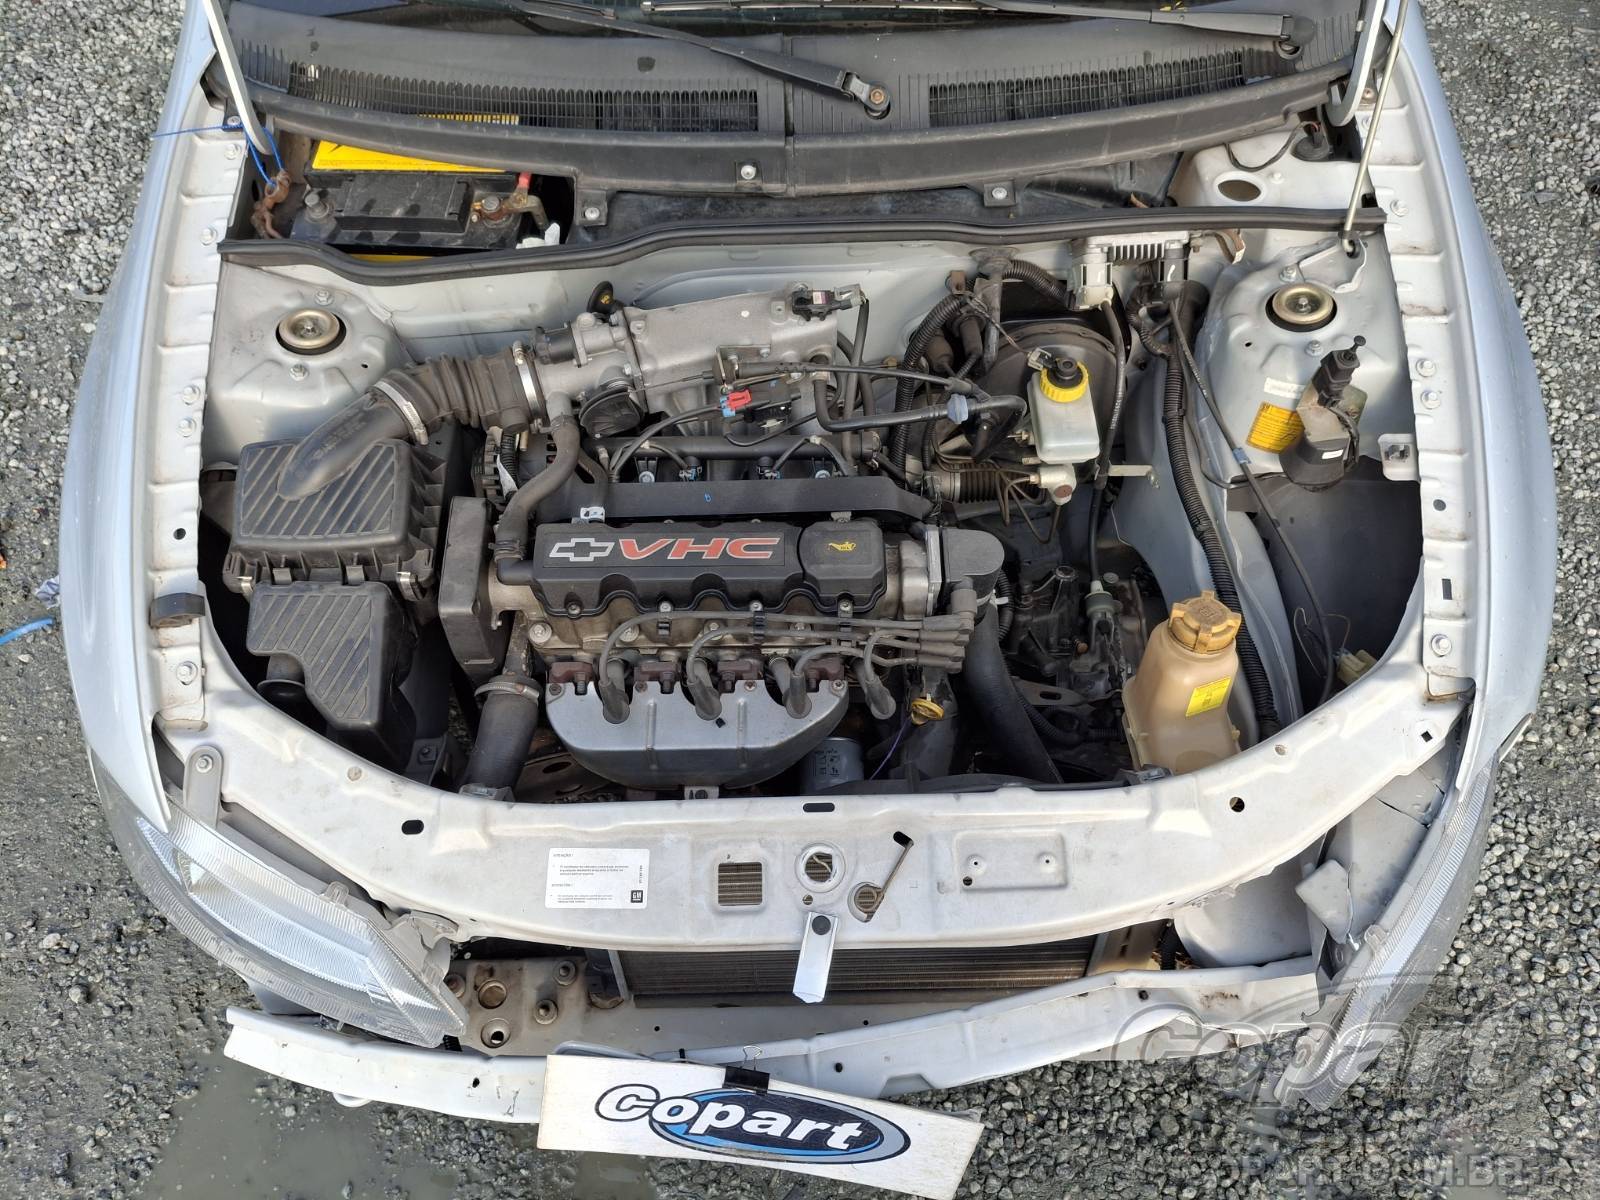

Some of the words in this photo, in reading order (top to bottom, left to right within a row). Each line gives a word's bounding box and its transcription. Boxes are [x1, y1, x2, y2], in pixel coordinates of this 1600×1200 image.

[618, 537, 781, 560] VHC
[632, 891, 642, 900] GM
[595, 1083, 862, 1150] Copart
